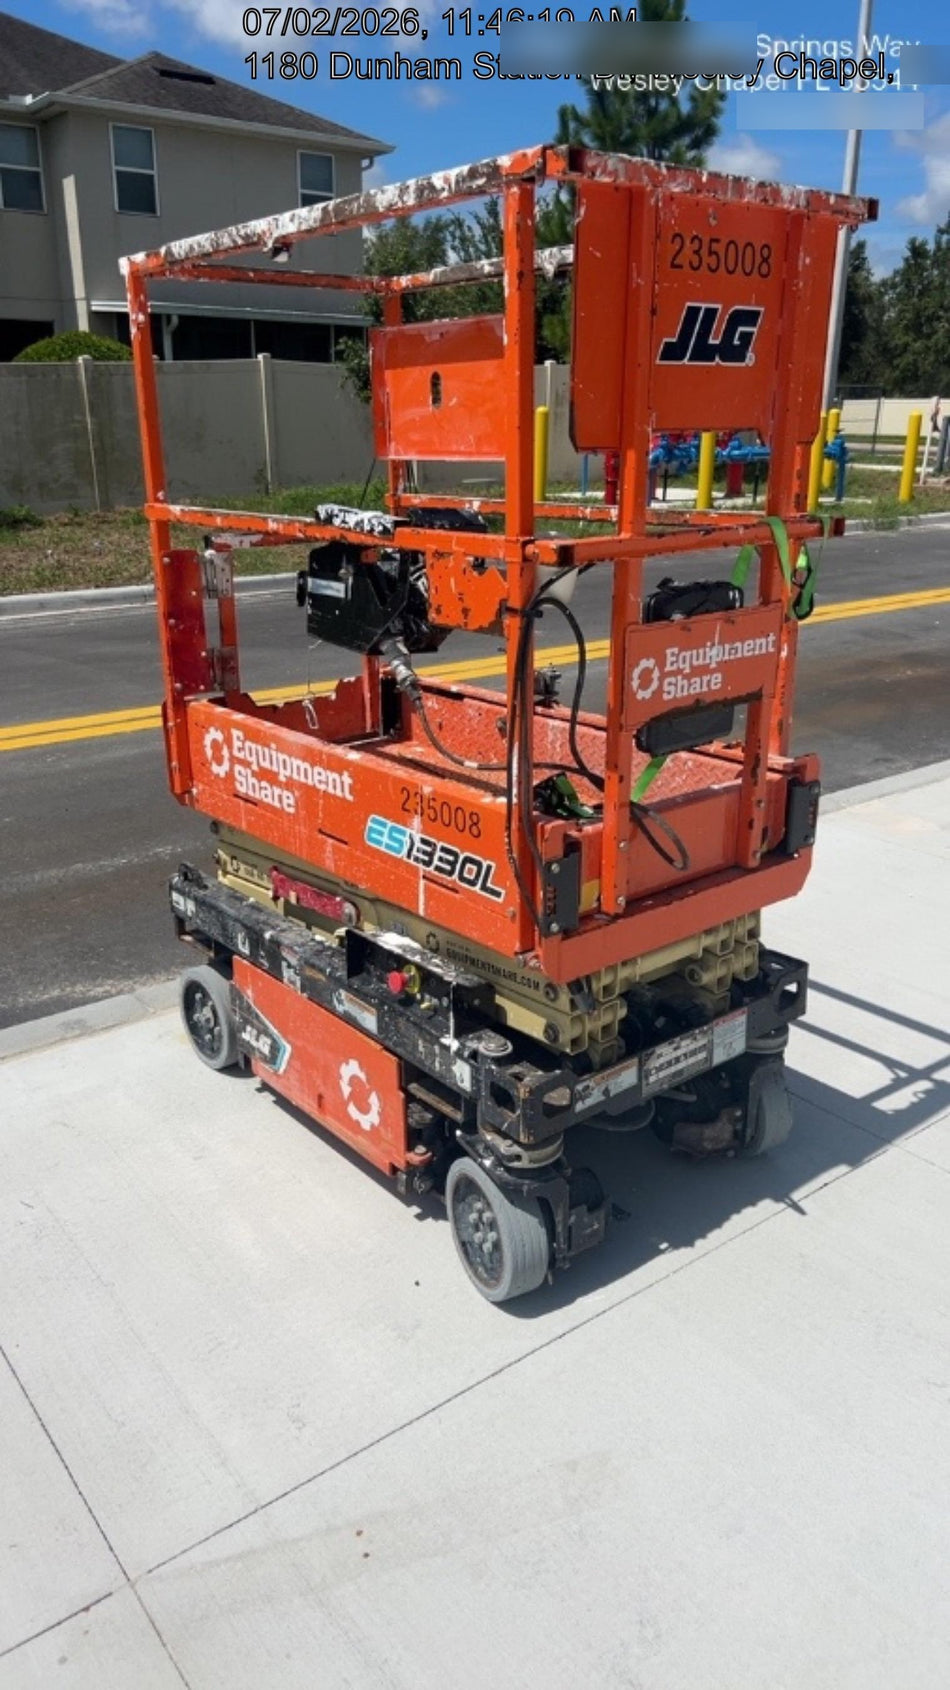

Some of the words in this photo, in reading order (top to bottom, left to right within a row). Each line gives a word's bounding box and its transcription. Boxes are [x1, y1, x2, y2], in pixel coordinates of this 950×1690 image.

[669, 232, 773, 279] 235008
[655, 302, 765, 367] JLG
[663, 631, 777, 674] Equipment
[661, 671, 723, 701] Share
[230, 727, 355, 802] Equipment
[233, 763, 297, 815] Share
[400, 785, 483, 839] 235008
[363, 813, 507, 904] ES1330L
